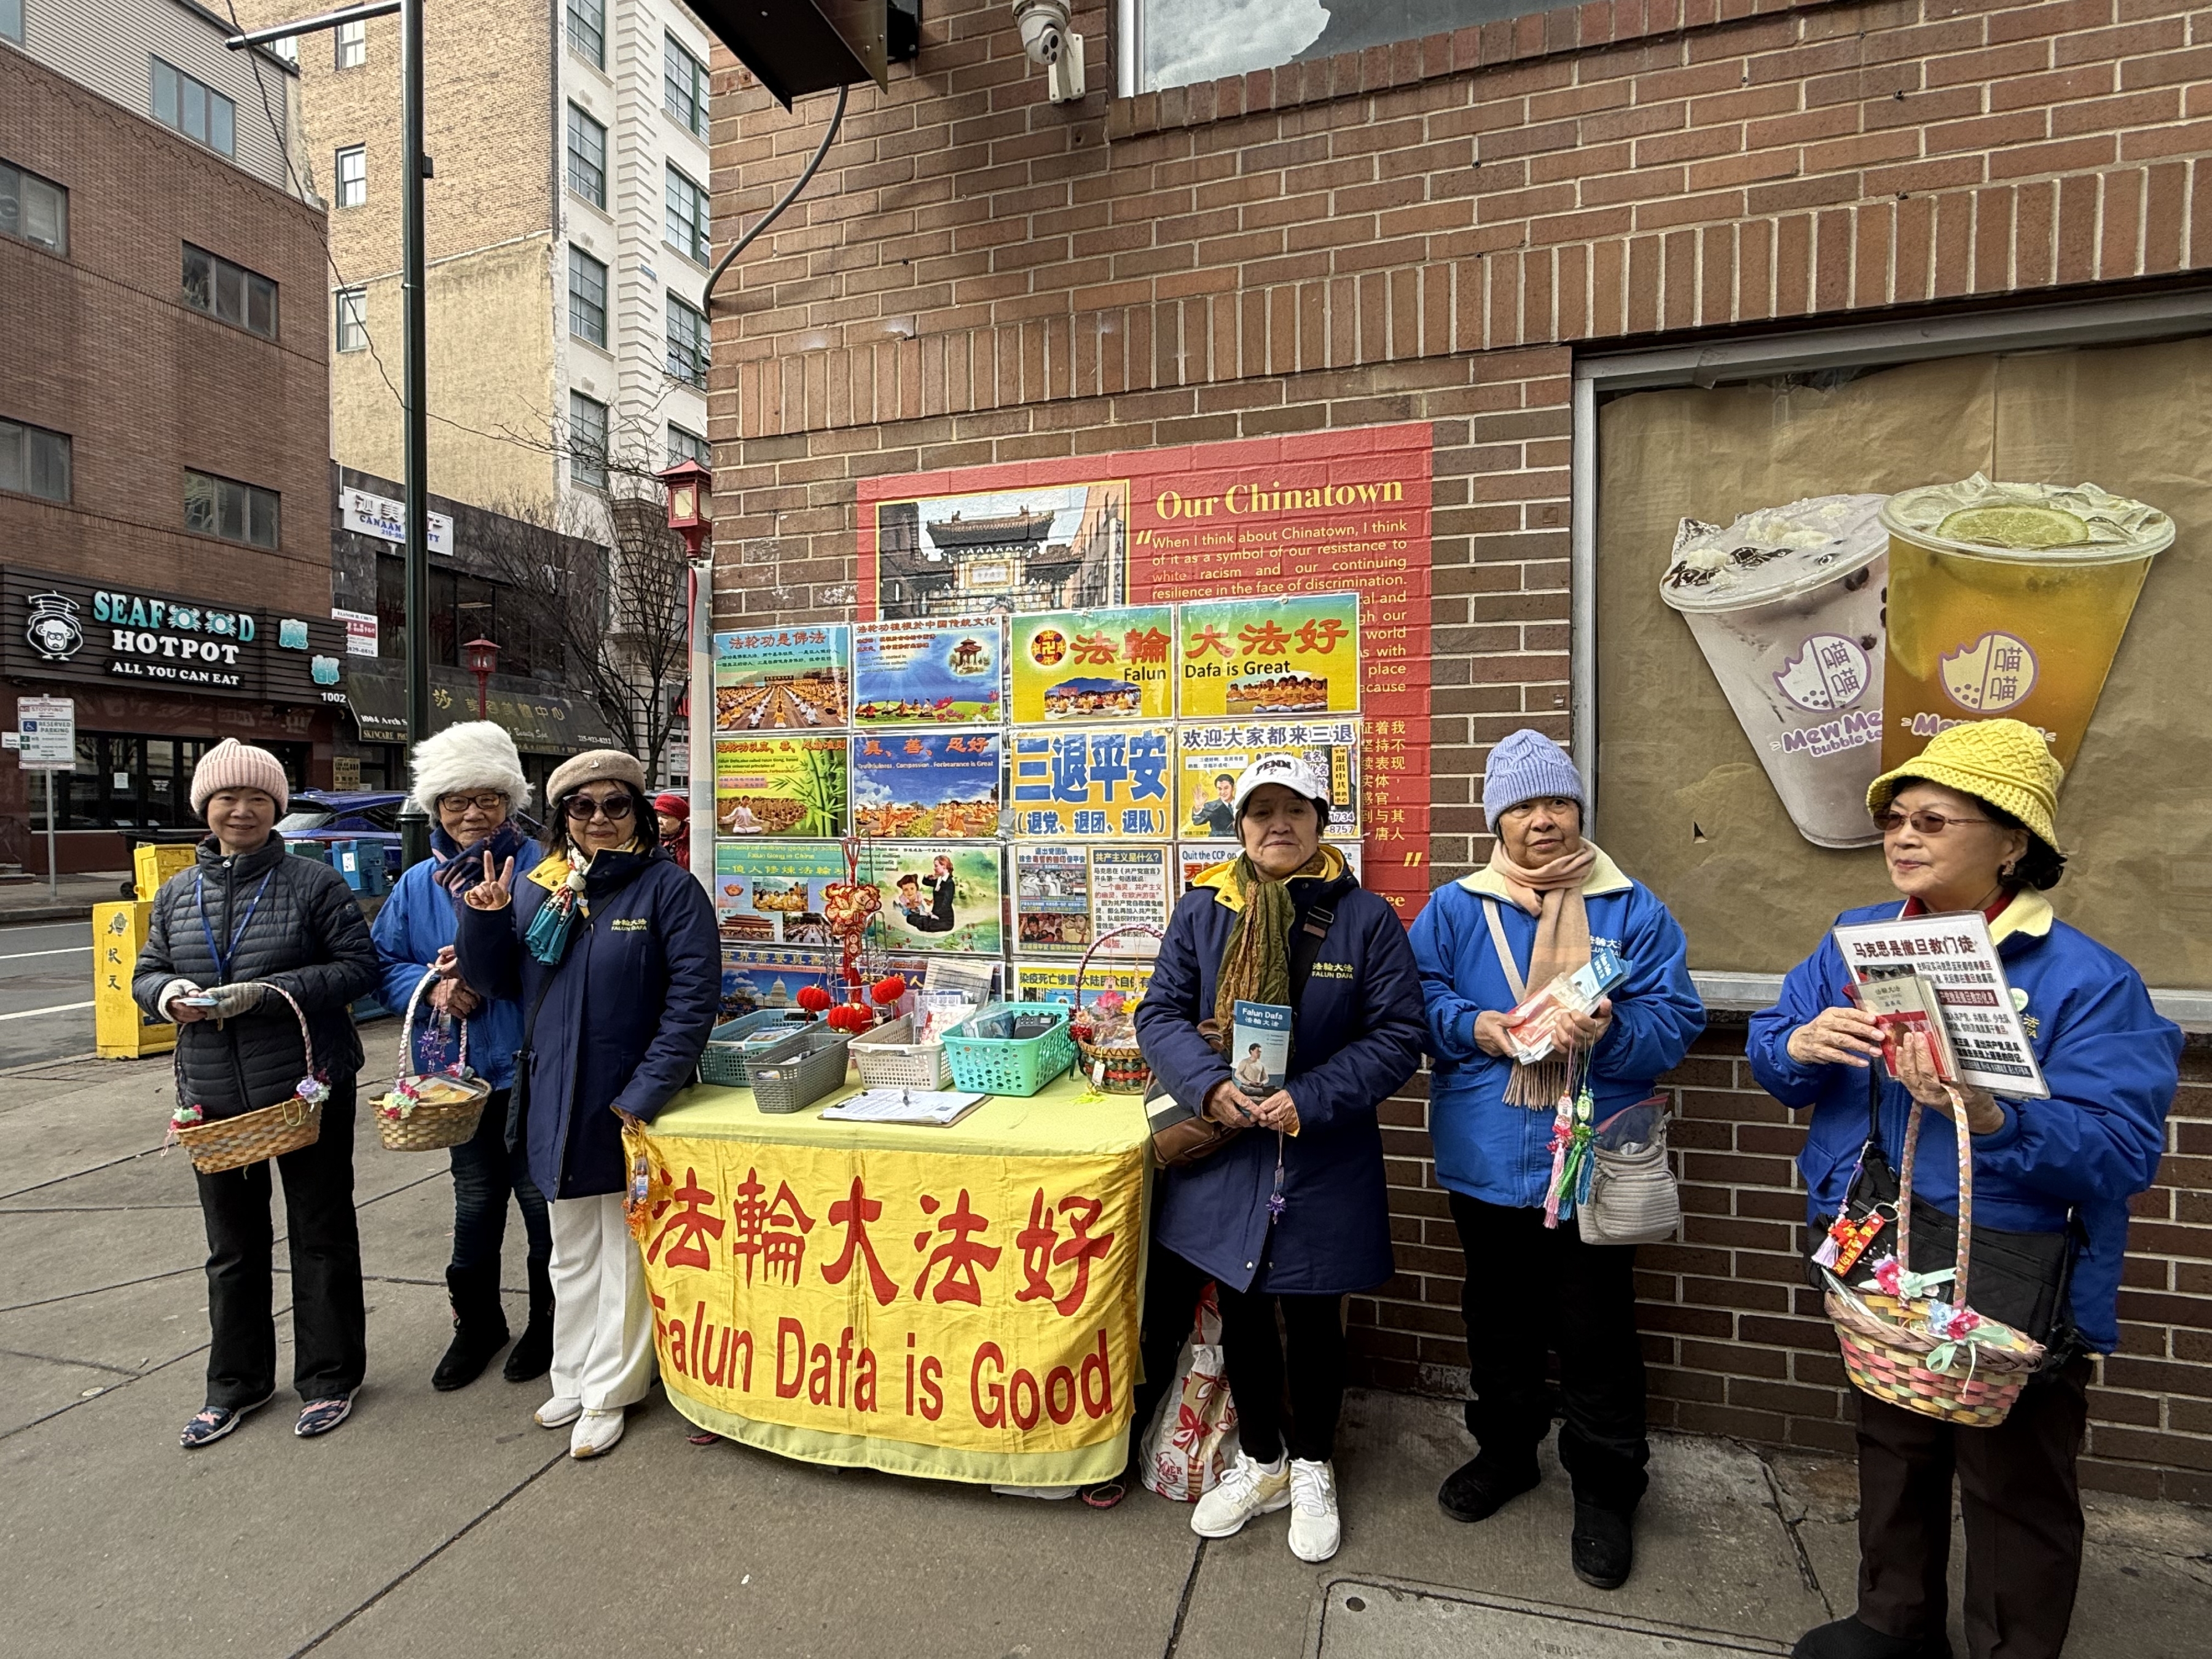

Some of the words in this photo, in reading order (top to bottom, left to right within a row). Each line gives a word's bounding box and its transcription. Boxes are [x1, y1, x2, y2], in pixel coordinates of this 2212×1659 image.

[1156, 490, 1218, 520] Our
[1225, 480, 1403, 514] Chinatown
[359, 515, 401, 532] CANAAN
[1194, 535, 1198, 546] I
[1202, 532, 1234, 546] think
[1238, 530, 1278, 544] about
[1282, 525, 1359, 542] Chinatown,
[1363, 523, 1367, 534] I
[1371, 519, 1408, 534] think
[1152, 554, 1167, 567] of
[1171, 554, 1180, 565] it
[1183, 555, 1199, 565] as
[1203, 555, 1210, 563] a
[1215, 548, 1264, 565] symbol
[1269, 546, 1284, 559] of
[1288, 547, 1312, 557] our
[1317, 540, 1387, 555] resistance
[1392, 539, 1408, 550] to
[1152, 570, 1187, 583] white
[1200, 567, 1242, 580] racism
[1255, 563, 1281, 576] and
[1295, 563, 1319, 574] our
[1332, 557, 1407, 572] continuing
[1152, 584, 1214, 600] resilience
[1215, 583, 1228, 597] in
[1231, 581, 1253, 596] the
[1255, 579, 1285, 594] face
[1287, 579, 1301, 592] of
[1304, 574, 1408, 591] discrimination.
[1379, 590, 1406, 603] and
[1382, 611, 1407, 621] our
[729, 629, 826, 649] 法轮功是佛法
[1185, 619, 1350, 659] 大法好
[1366, 626, 1406, 640] world
[112, 629, 239, 664] HOTPOT
[1070, 627, 1171, 665] 法輪
[1376, 644, 1406, 657] with
[112, 662, 143, 675] ALL
[147, 665, 176, 678] YOU
[179, 670, 209, 682] CAN
[213, 673, 239, 685] EAT
[1124, 667, 1167, 682] Falun
[1185, 662, 1222, 679] Dafa
[1226, 662, 1240, 677] is
[1244, 661, 1290, 675] Great
[1368, 662, 1406, 678] place
[1820, 641, 1861, 696] 喵喵
[1990, 646, 2023, 702] 喵喵
[321, 692, 346, 702] 1002
[364, 730, 394, 740] SKINCARE
[1183, 724, 1353, 747] 欢迎大家都来三退
[1783, 723, 1841, 751] Mew
[1843, 712, 1883, 734] Me
[1811, 735, 1864, 755] bubble
[1866, 730, 1883, 740] te
[1015, 729, 1167, 804] 三退平安
[1256, 760, 1292, 776] PENN
[1375, 827, 1405, 841] 唐人
[1182, 850, 1198, 861] Quit
[1199, 850, 1210, 860] the
[1212, 850, 1225, 860] CCP
[1853, 935, 1977, 959] 马克思是撒旦教门徒
[1312, 962, 1354, 973] 法輪大法
[1242, 1007, 1263, 1018] Falun
[1265, 1011, 1283, 1021] Dafa
[647, 1166, 1116, 1317] 法輪大法好
[776, 1316, 878, 1413] Dafa
[906, 1332, 944, 1421] is
[971, 1328, 1113, 1431] Good
